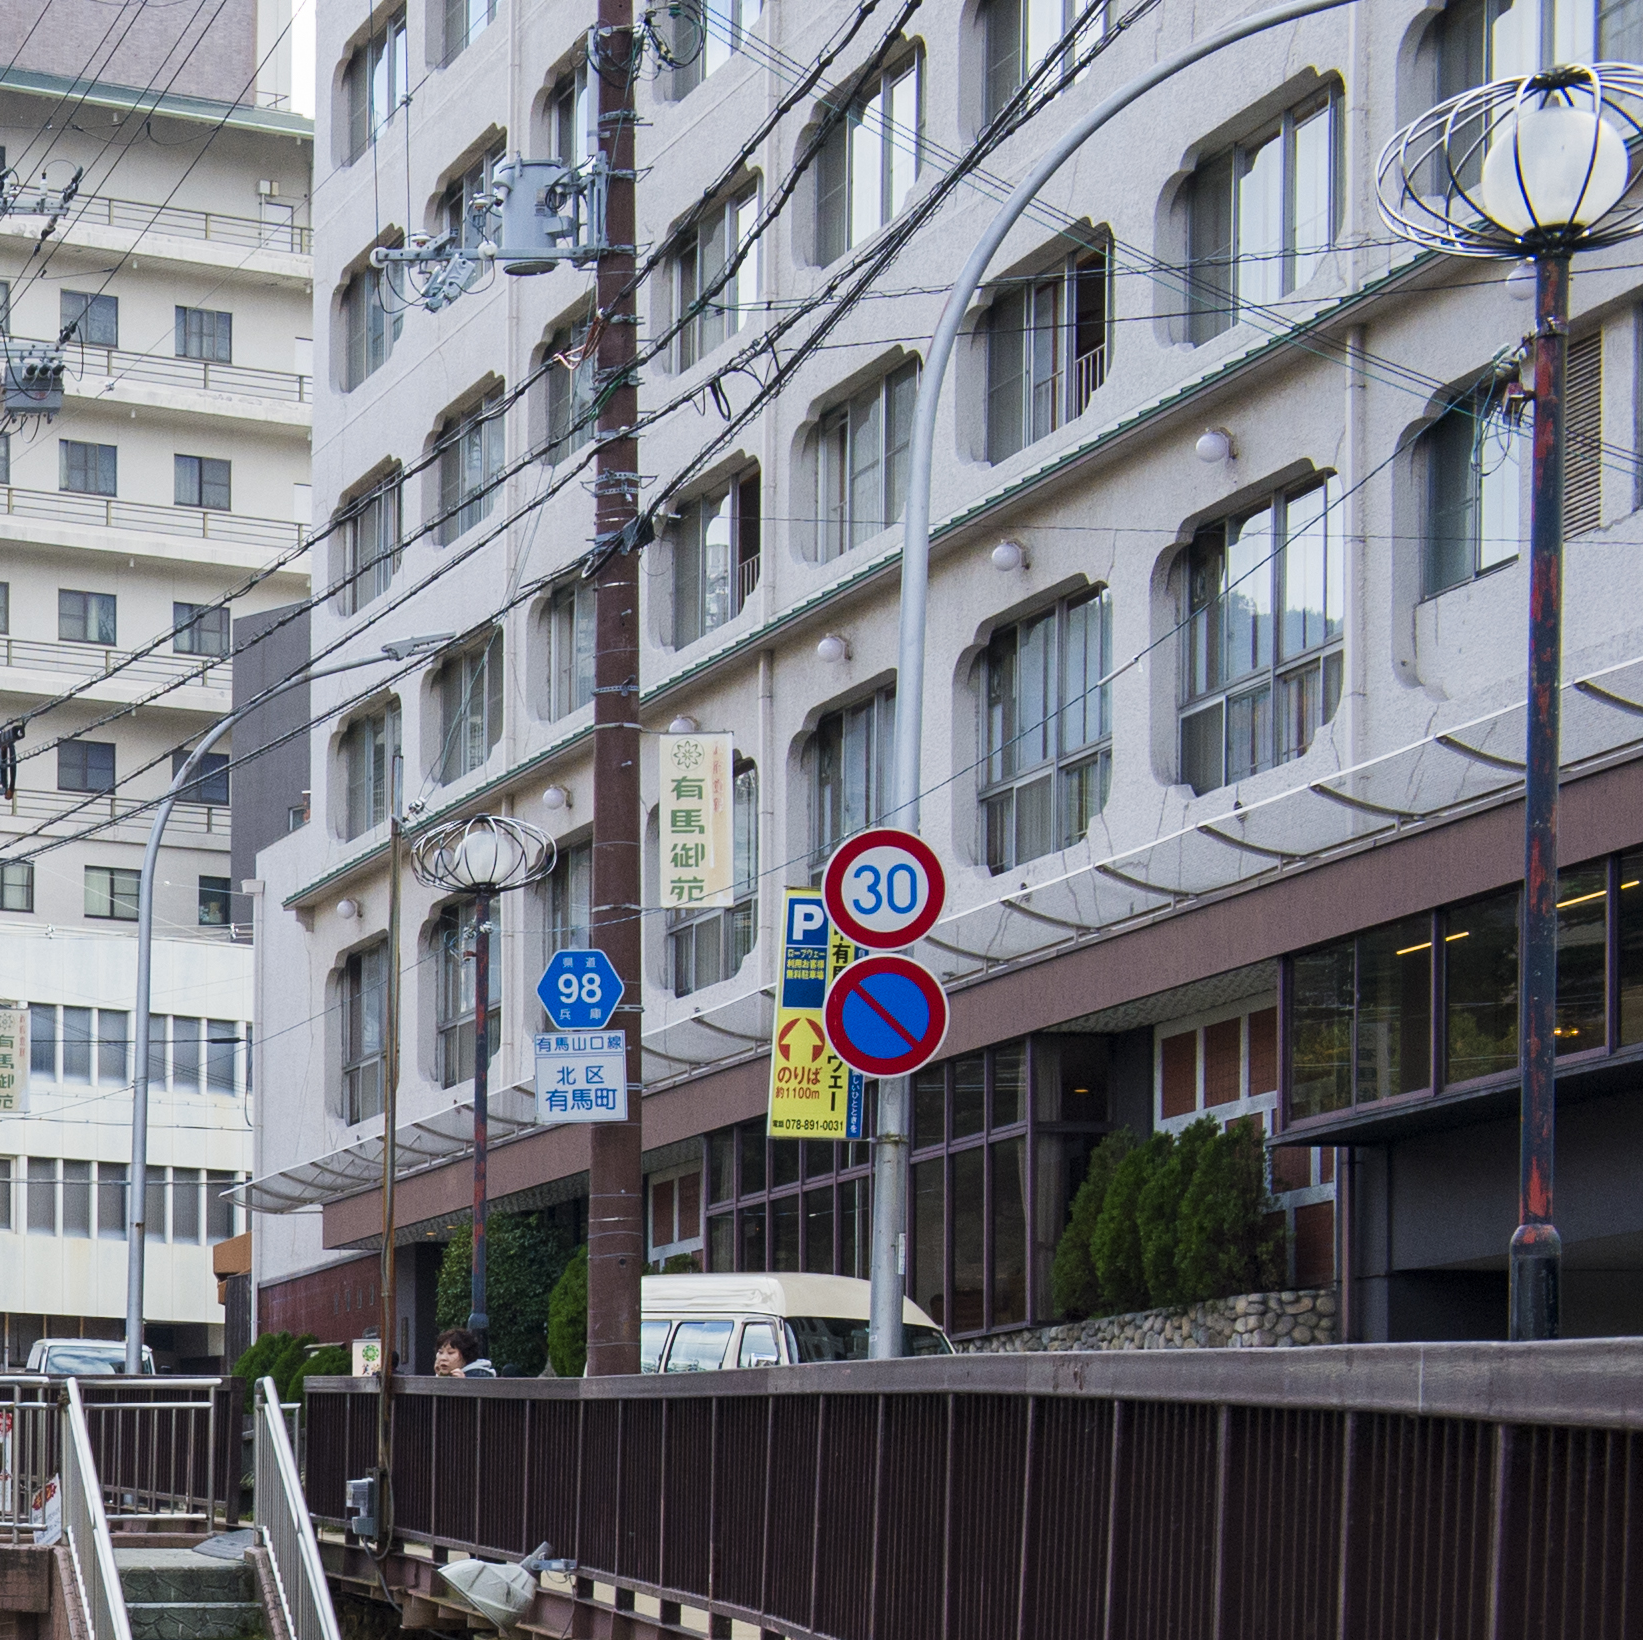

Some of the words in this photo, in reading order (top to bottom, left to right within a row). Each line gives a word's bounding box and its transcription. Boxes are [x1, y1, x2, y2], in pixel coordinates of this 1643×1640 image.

[669, 775, 706, 902] 有馬御苑
[853, 863, 918, 915] 30
[792, 904, 825, 940] P
[562, 956, 597, 969] 県道
[787, 948, 826, 959] ロープウェー
[557, 973, 602, 1004] 98
[559, 1008, 602, 1020] 兵庫
[537, 1035, 623, 1053] 有馬山口線
[556, 1065, 605, 1086] 北区
[777, 1066, 823, 1086] のりば
[545, 1087, 618, 1112] 有馬町
[775, 1086, 820, 1100] 約1100m
[785, 1118, 844, 1131] 078-891-0031
